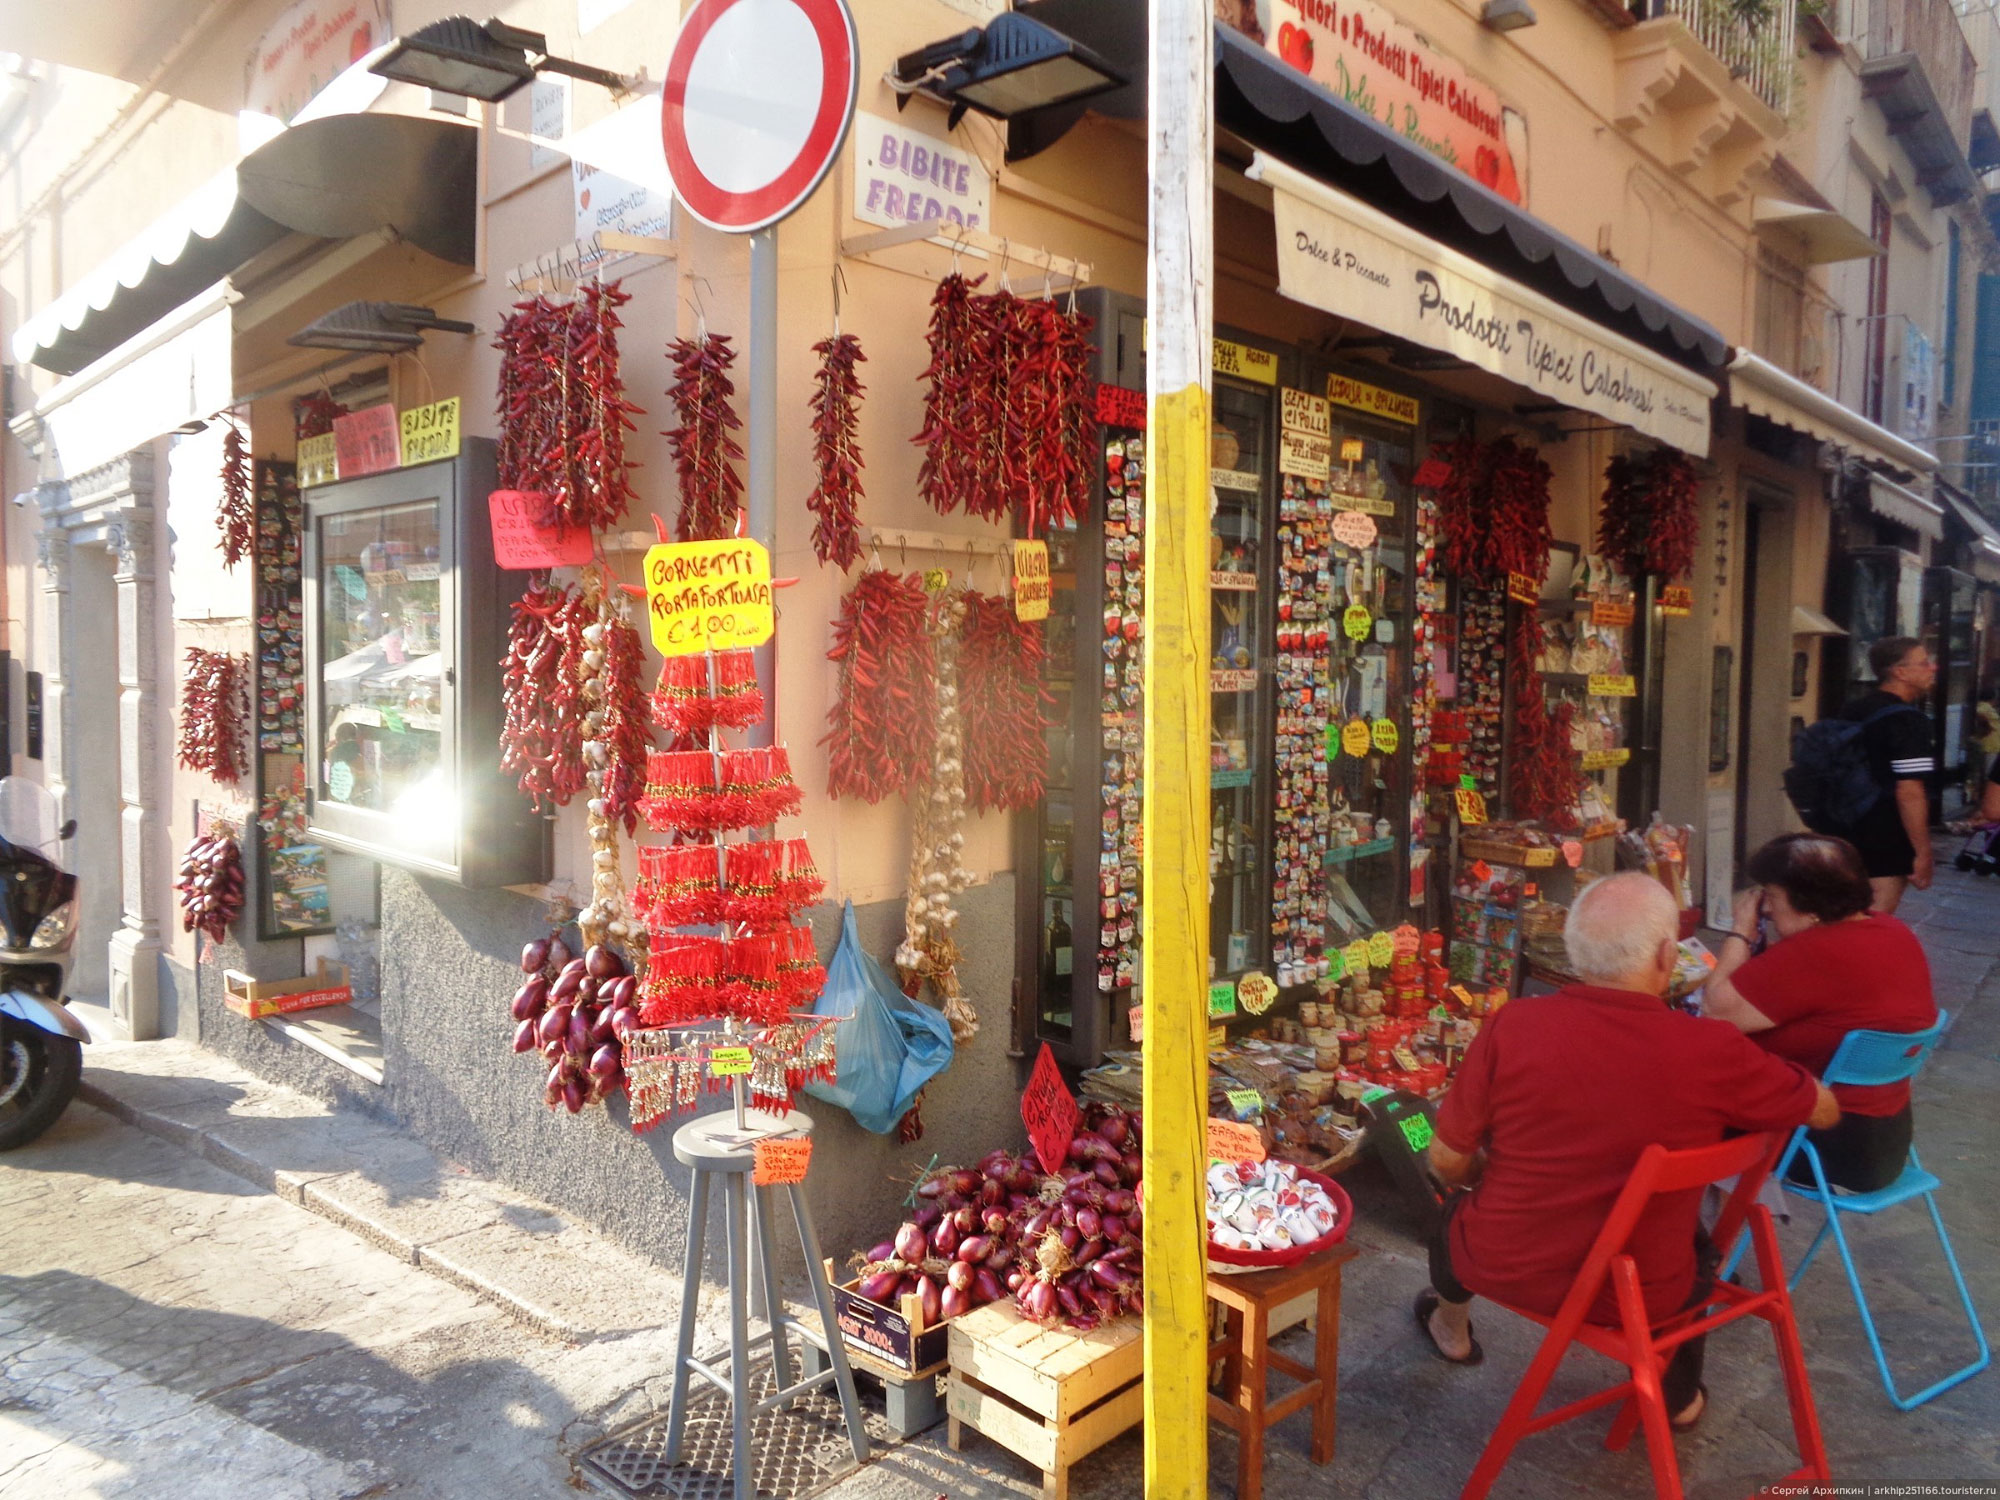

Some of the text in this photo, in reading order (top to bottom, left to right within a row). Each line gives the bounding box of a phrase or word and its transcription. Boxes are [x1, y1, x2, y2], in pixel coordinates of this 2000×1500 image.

[1281, 0, 1336, 33] quori
[1353, 13, 1407, 80] Prodotti
[1410, 53, 1444, 105] Tipici
[1448, 79, 1500, 141] Calabresi
[879, 134, 971, 196] BIBITE
[1296, 231, 1328, 262] Dolce
[1332, 248, 1341, 268] &
[1345, 253, 1391, 288] Piccante
[1415, 269, 1511, 354] Prodotti
[1517, 319, 1574, 384] Tipici
[1581, 351, 1653, 414] Calabresi
[1213, 340, 1237, 358] POLLA
[1213, 354, 1240, 373] OPEA
[1284, 390, 1311, 411] SEMI
[1284, 409, 1328, 434] CIPOLLA
[651, 580, 770, 620] PORTAFORTUNA
